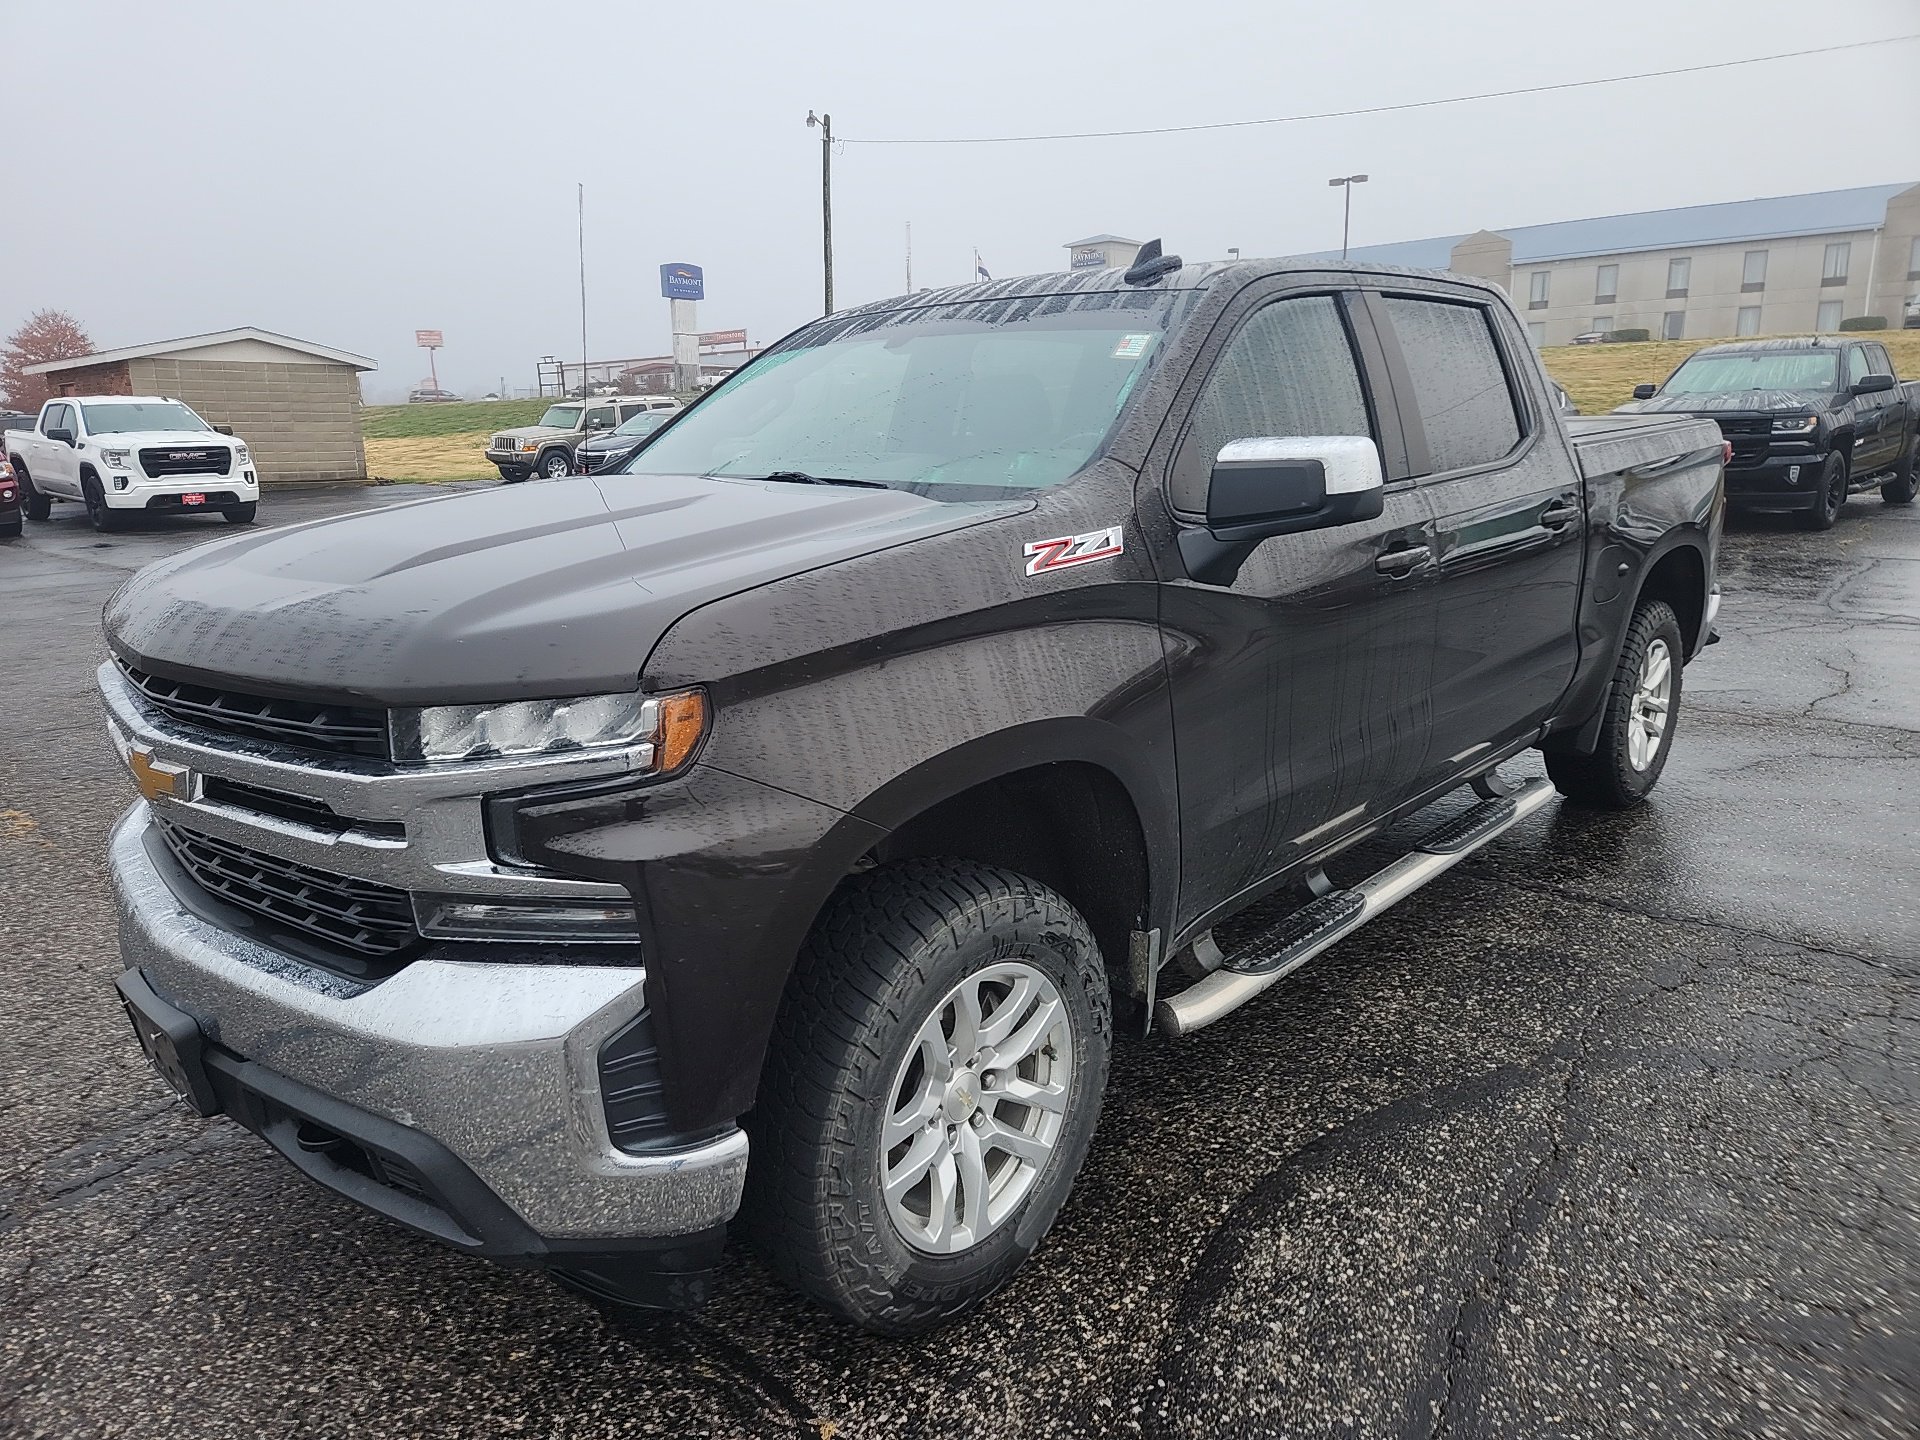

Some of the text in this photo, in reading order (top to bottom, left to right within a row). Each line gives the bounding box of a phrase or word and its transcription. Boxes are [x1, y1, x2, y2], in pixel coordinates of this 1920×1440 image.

[669, 275, 702, 287] BAYMONT
[169, 452, 207, 460] GMC
[1023, 525, 1125, 577] Z71
